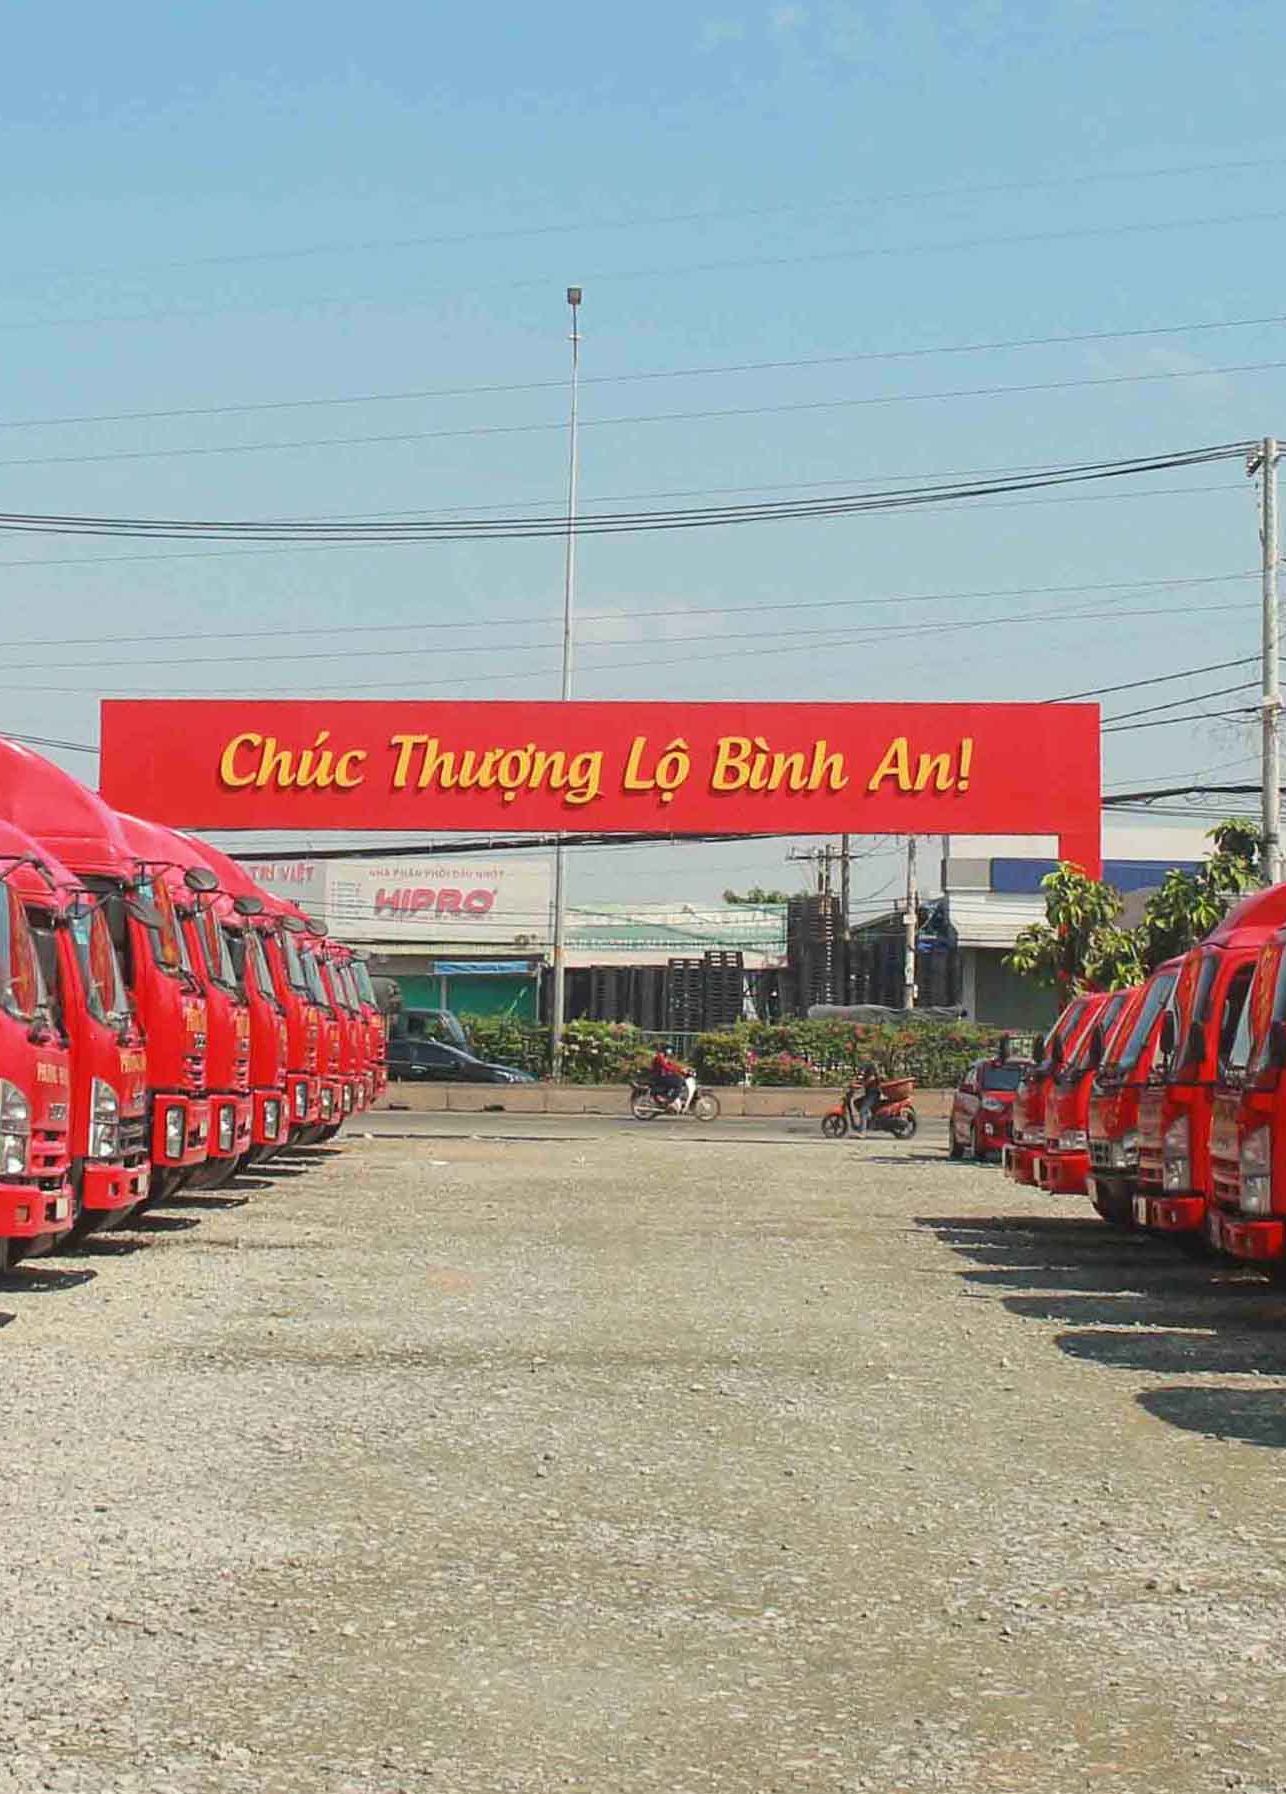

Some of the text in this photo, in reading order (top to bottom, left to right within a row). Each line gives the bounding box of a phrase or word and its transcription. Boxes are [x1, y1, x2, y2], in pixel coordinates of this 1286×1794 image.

[219, 731, 975, 804] Chúc Thượng Lộ Bình An!
[373, 887, 495, 914] HIPRO
